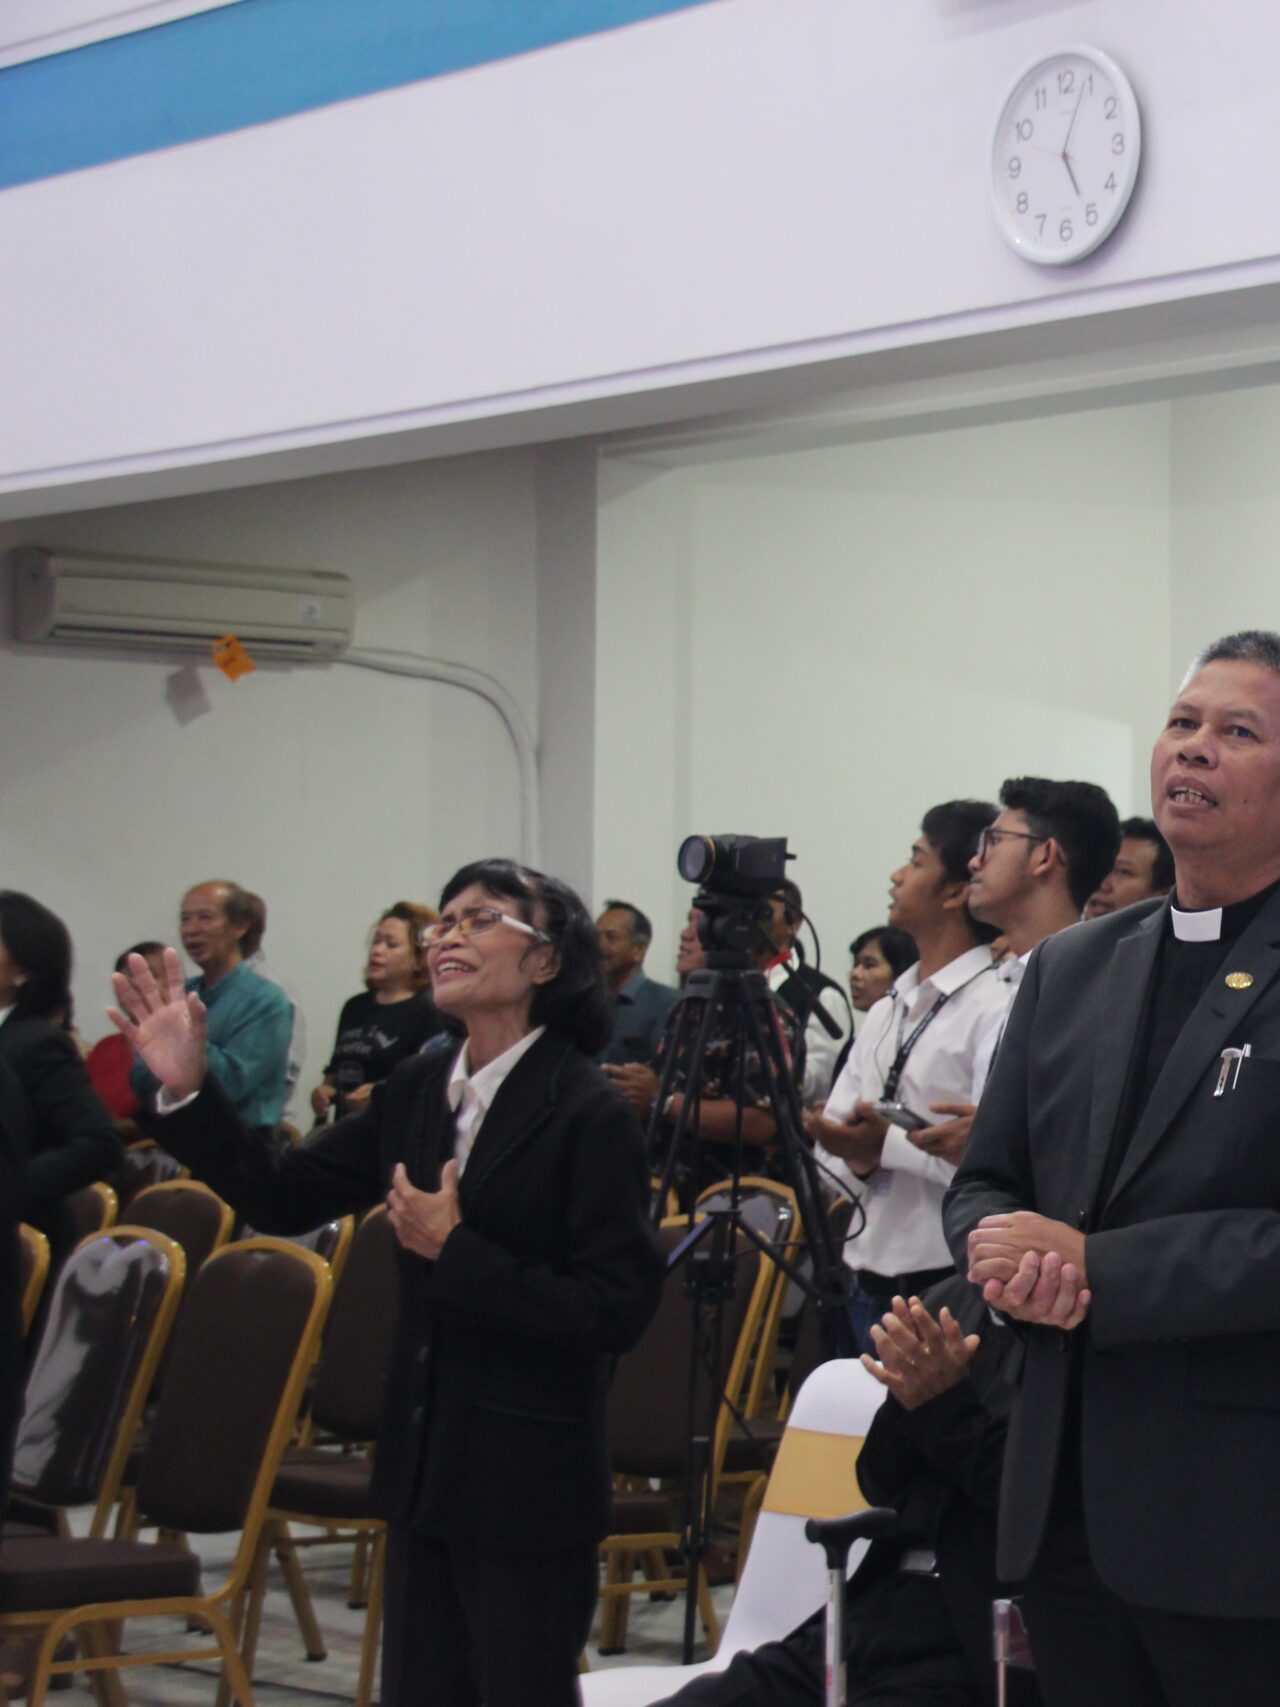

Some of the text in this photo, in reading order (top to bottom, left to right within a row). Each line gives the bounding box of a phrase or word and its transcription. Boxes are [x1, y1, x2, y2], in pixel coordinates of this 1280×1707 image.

[1057, 70, 1075, 95] 12
[1087, 74, 1094, 96] 1
[1034, 87, 1047, 111] 11
[1103, 96, 1118, 121] 2
[1015, 118, 1034, 143] 10
[1111, 132, 1126, 156] 3
[1007, 156, 1022, 180] 9
[1103, 171, 1118, 194] 4
[1016, 191, 1029, 215] 8
[1085, 202, 1099, 227] 5
[1034, 213, 1047, 237] 7
[1059, 219, 1074, 242] 6
